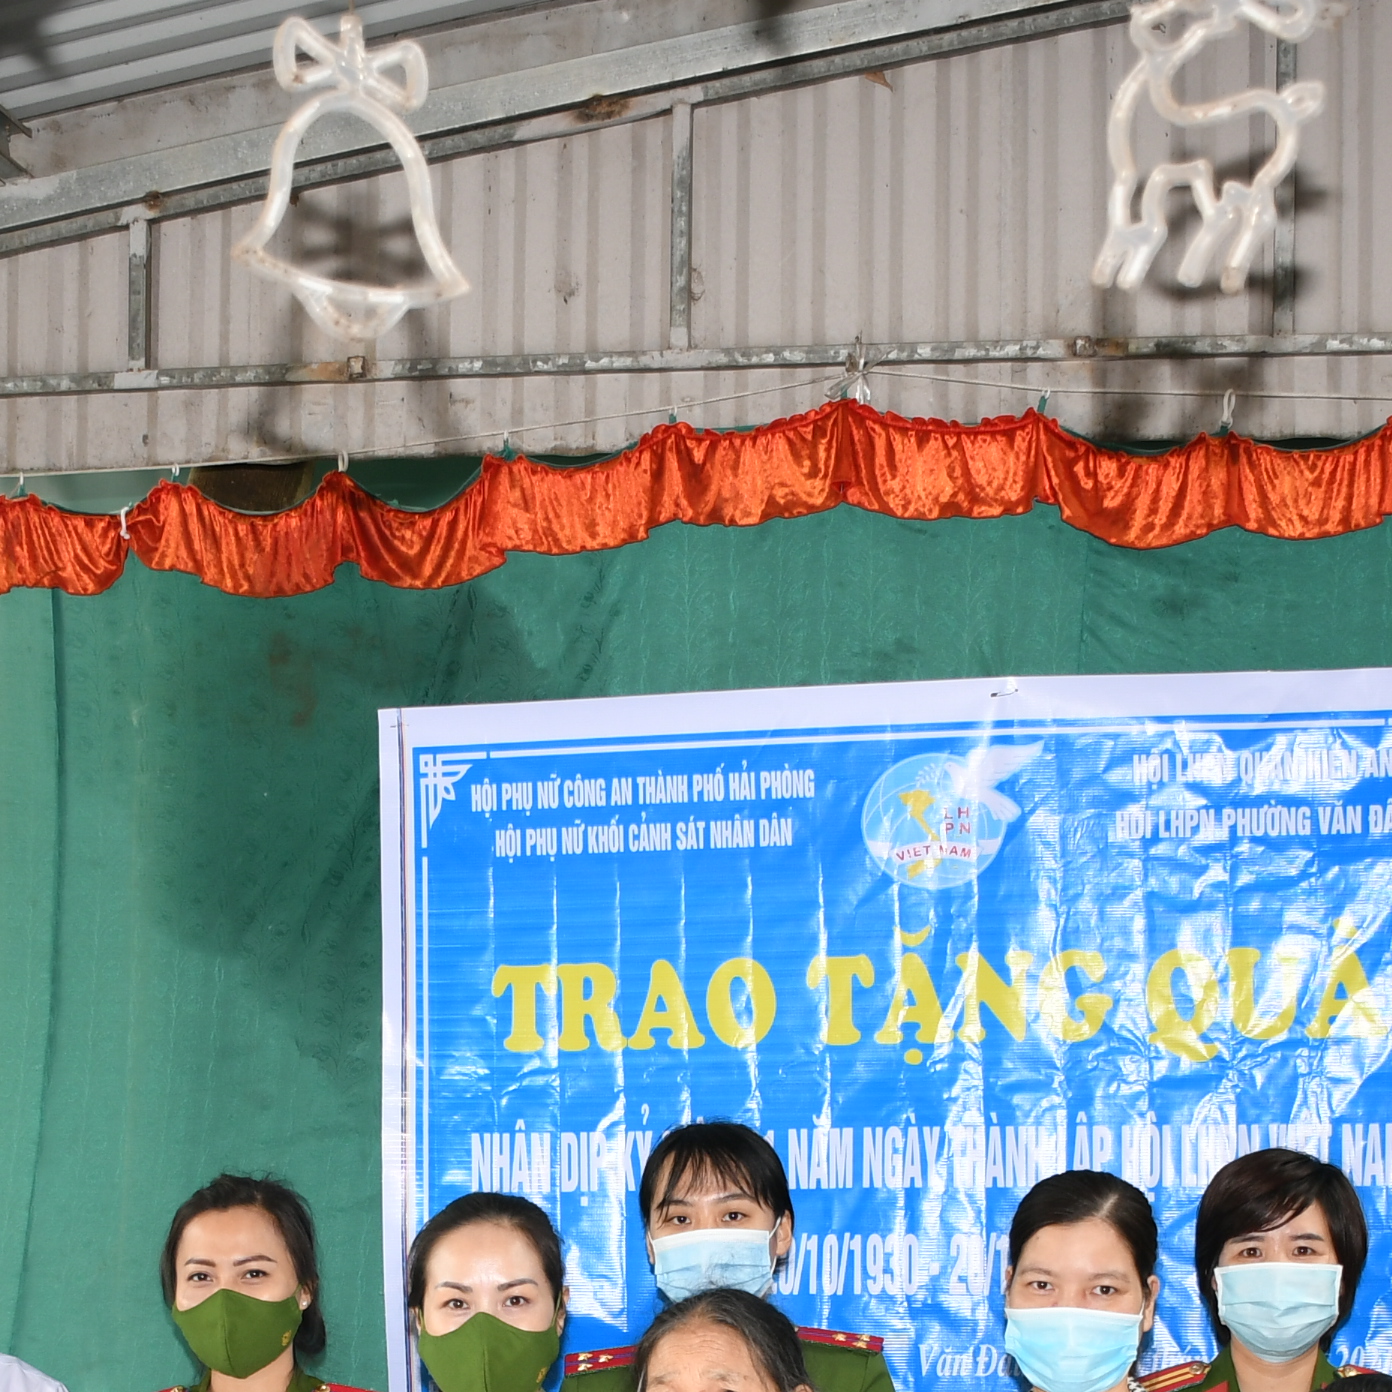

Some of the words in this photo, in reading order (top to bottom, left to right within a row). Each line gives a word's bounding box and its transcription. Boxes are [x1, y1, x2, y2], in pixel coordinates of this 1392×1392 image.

[471, 778, 497, 818] HỘI
[501, 783, 533, 816] PHỤ
[537, 774, 562, 809] NỮ
[563, 774, 606, 808] CÔNG
[610, 778, 633, 806] AN
[637, 770, 689, 804] THÀNH
[693, 763, 725, 802] PHỐ
[729, 760, 756, 800] HẢI
[760, 763, 815, 799] PHÒNG
[1158, 808, 1216, 839] LHPN
[1221, 800, 1312, 838] PHƯỜNG
[1317, 801, 1363, 835] VĂN
[495, 823, 521, 863] HỘI
[526, 828, 557, 861] PHỤ
[561, 819, 585, 854] NỮ
[588, 814, 624, 853] KHỐI
[628, 812, 672, 852] CẢNH
[676, 815, 706, 850] SÁT
[710, 814, 755, 849] NHÂN
[759, 812, 793, 847] DÂN
[491, 958, 777, 1053] TRAO
[806, 924, 1113, 1066] TẶNG
[1145, 917, 1391, 1063] QUÀ
[471, 1118, 552, 1194] NHÂN
[560, 1131, 609, 1207] DỊP
[787, 1113, 854, 1190] NĂM
[863, 1112, 941, 1189] NGÀY
[771, 1232, 919, 1296] 0/10/1930
[918, 1343, 974, 1378] Văn
